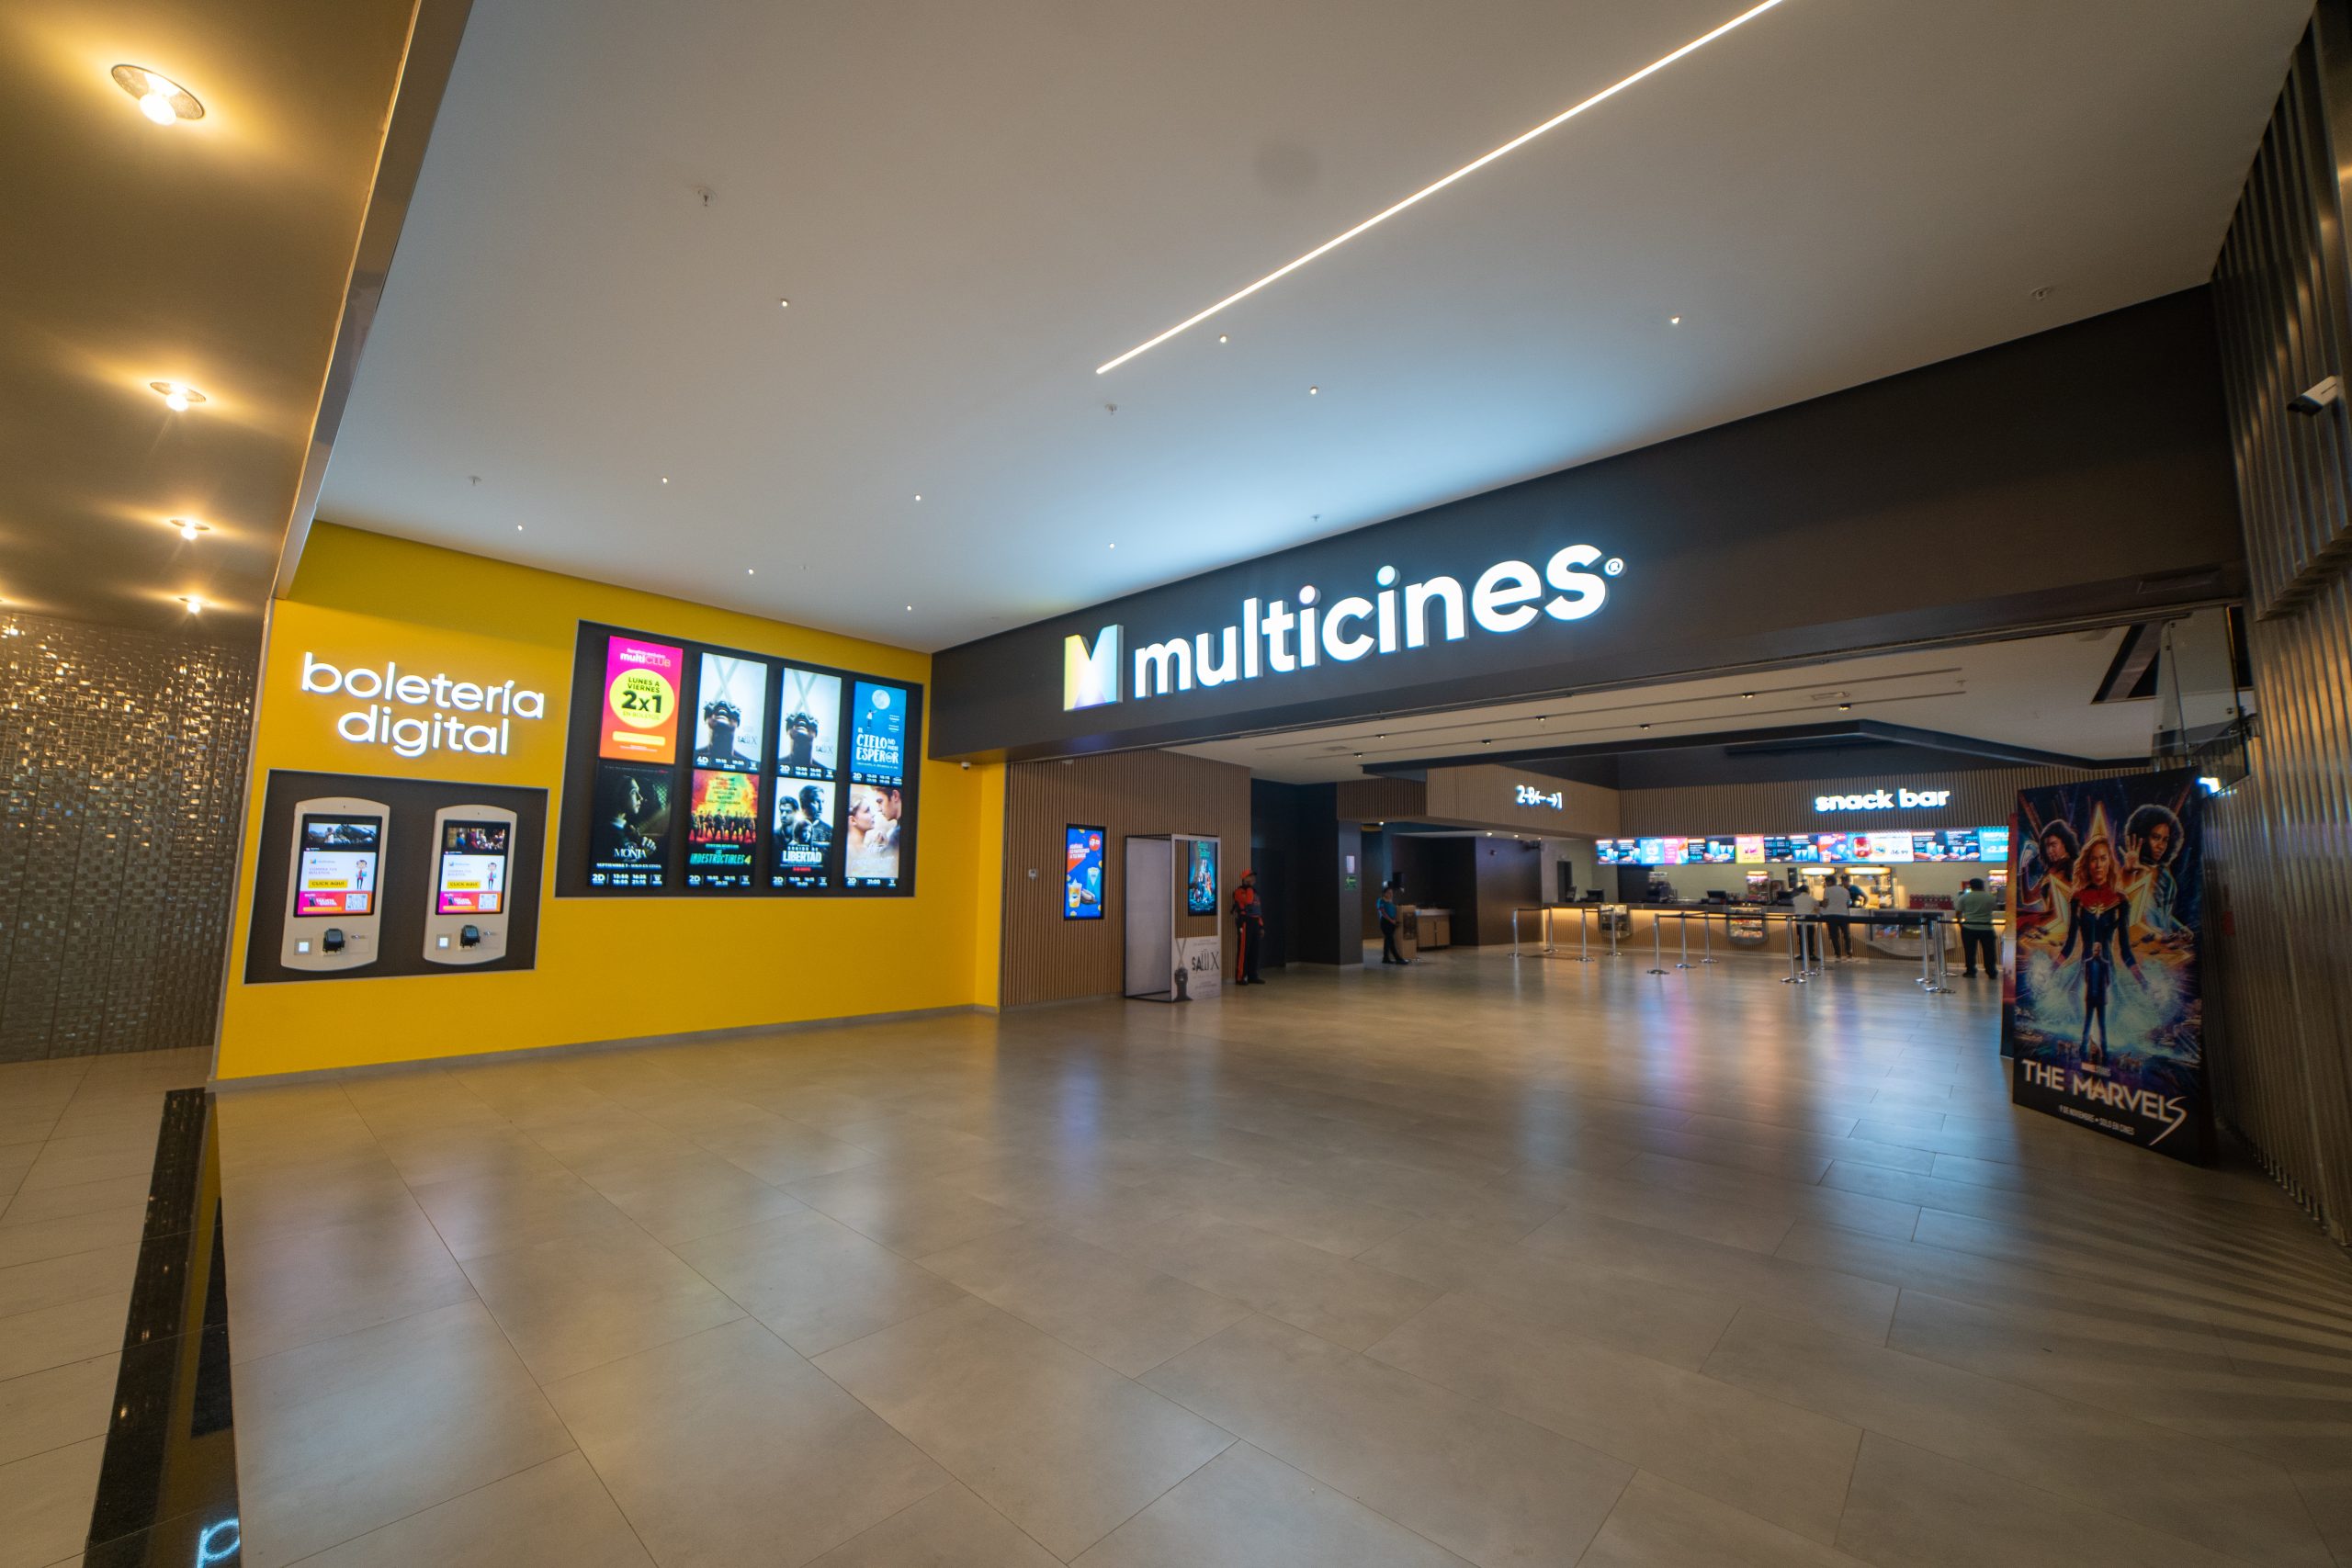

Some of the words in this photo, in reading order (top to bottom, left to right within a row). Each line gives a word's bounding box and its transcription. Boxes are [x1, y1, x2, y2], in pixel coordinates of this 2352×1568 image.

[1134, 544, 1610, 700] multicines
[301, 651, 545, 719] boletería
[628, 676, 653, 686] LUNES
[628, 682, 661, 694] VIERNES
[621, 690, 662, 713] 2x1
[337, 704, 510, 757] digital
[856, 734, 888, 749] CIELO
[855, 746, 899, 764] ESPER@R
[1815, 789, 1894, 812] snack
[1898, 788, 1951, 808] bar
[782, 850, 822, 863] LIBERTAD
[2021, 1058, 2065, 1091] THE
[2073, 1073, 2188, 1146] MARVELS
